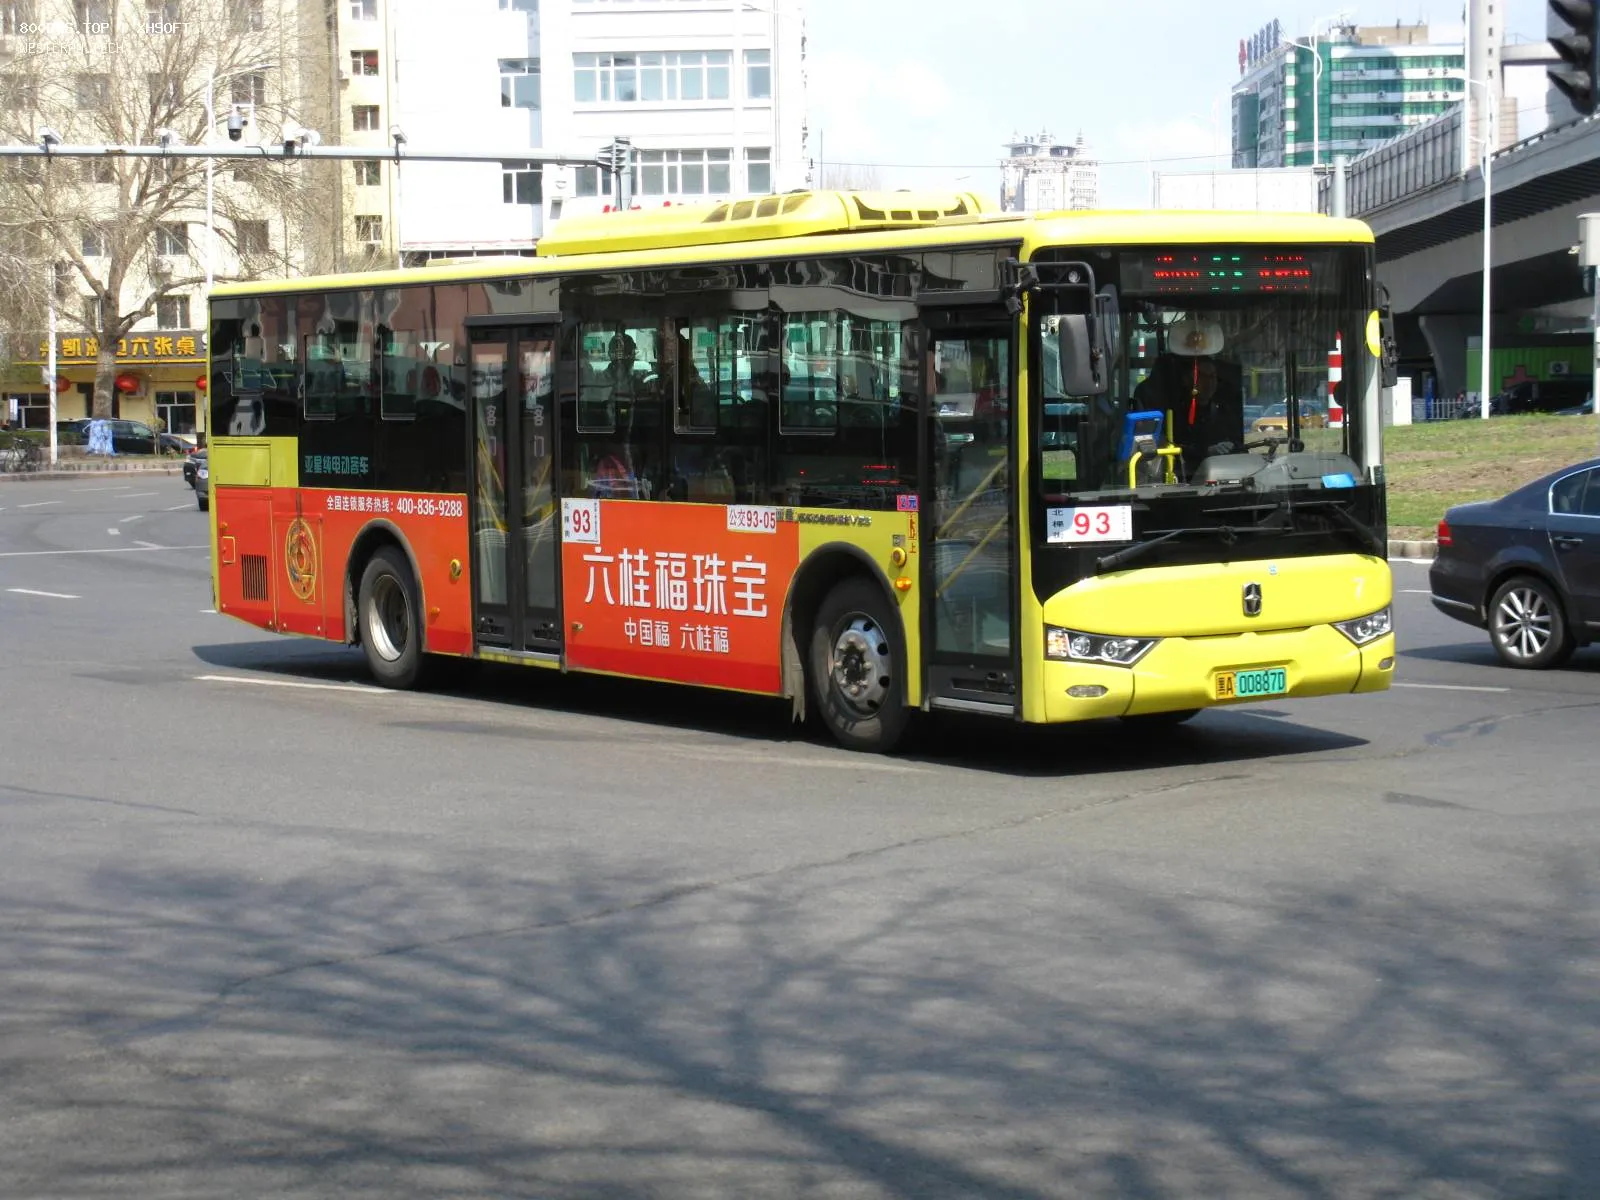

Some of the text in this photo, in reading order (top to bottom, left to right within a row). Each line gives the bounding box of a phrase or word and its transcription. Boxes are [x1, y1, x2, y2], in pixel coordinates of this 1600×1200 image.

[573, 509, 591, 534] 93
[1074, 511, 1111, 536] 93
[583, 546, 768, 618] 六桂福珠宝
[624, 617, 730, 654] 中国福 六桂福
